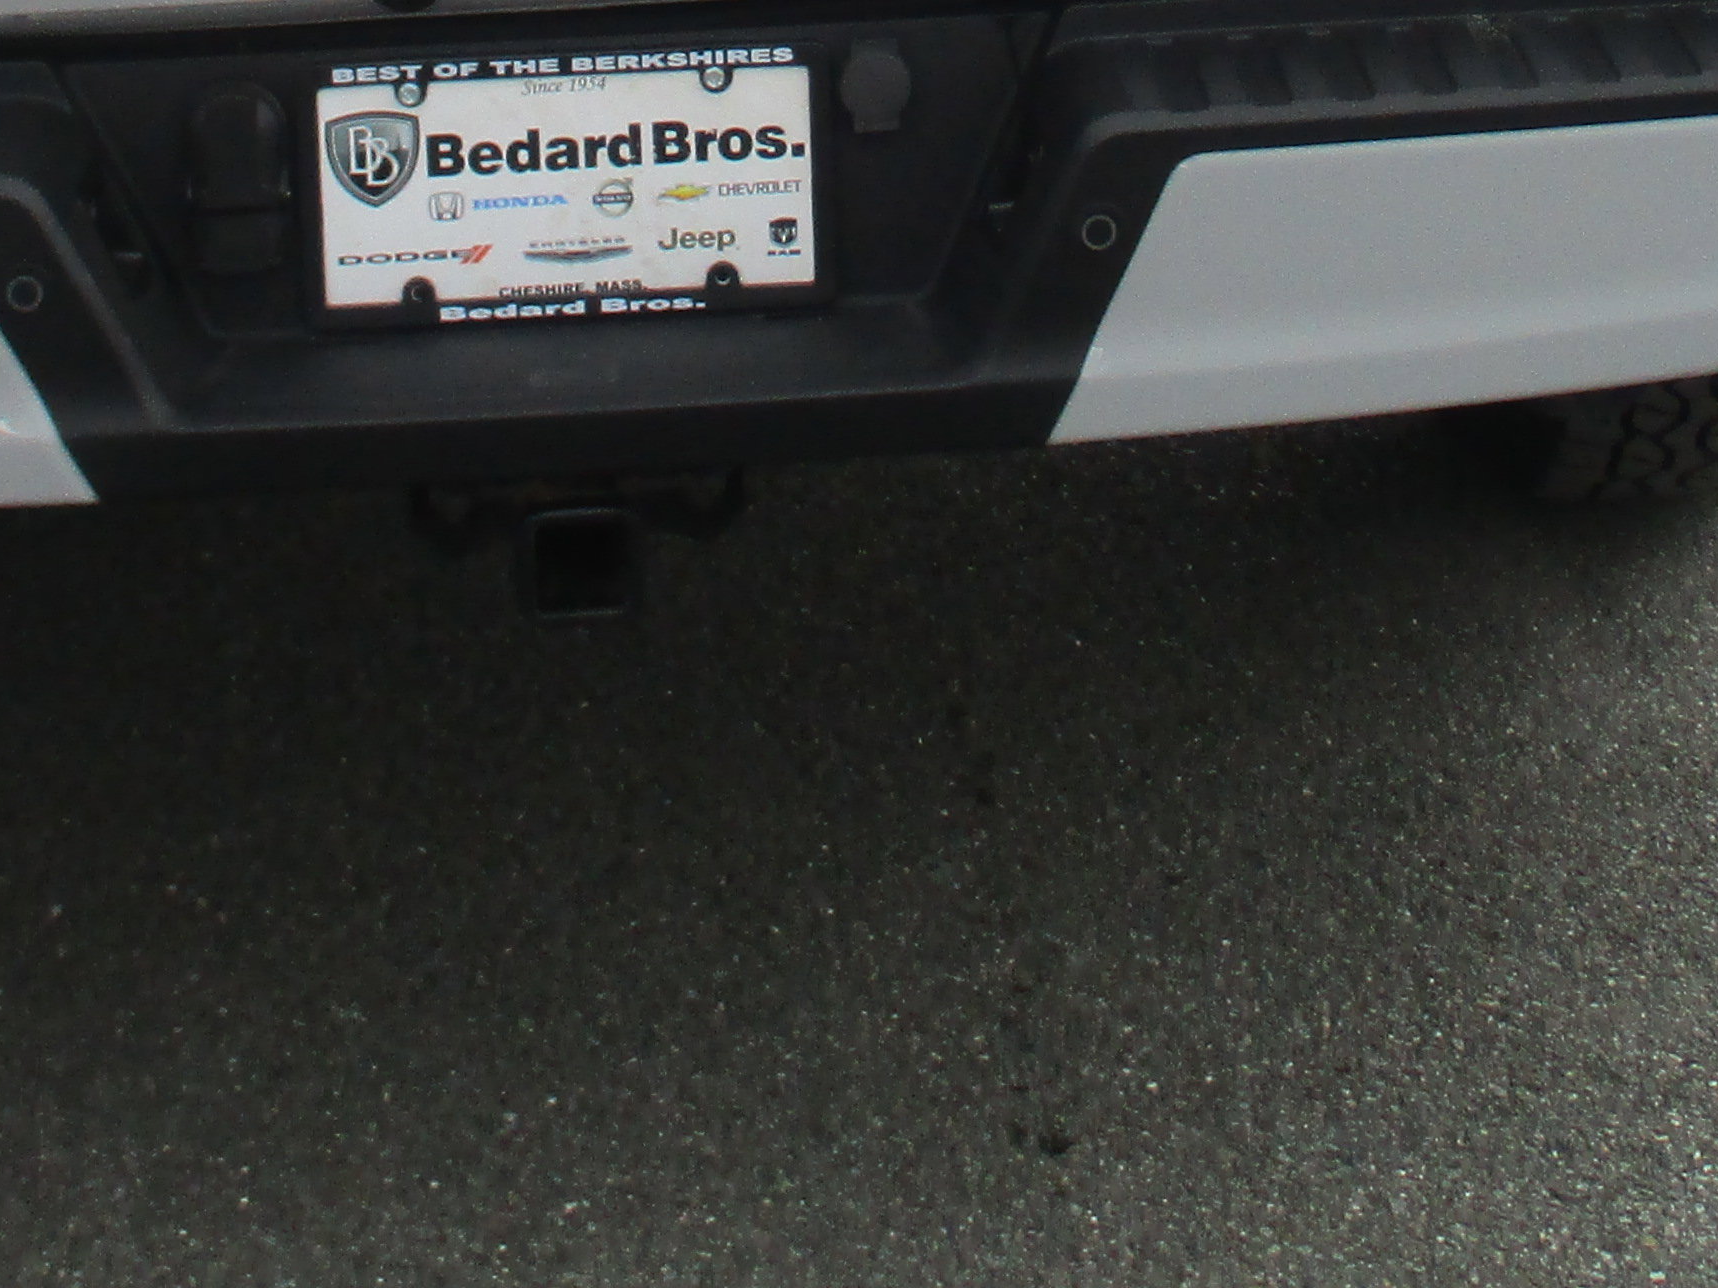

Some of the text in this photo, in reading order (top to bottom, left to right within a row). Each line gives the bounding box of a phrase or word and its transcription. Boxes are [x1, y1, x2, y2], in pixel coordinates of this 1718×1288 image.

[332, 47, 794, 84] BEST OF THE BERKSHIRES
[520, 75, 607, 96] Since 1954
[426, 120, 806, 178] Bedard Bros.
[718, 179, 803, 197] CHEVROLET
[471, 194, 569, 211] HONDA
[657, 227, 736, 252] Jeep
[499, 278, 647, 299] CHESHIRE MASS.
[439, 295, 707, 323] Bedard Bros.
